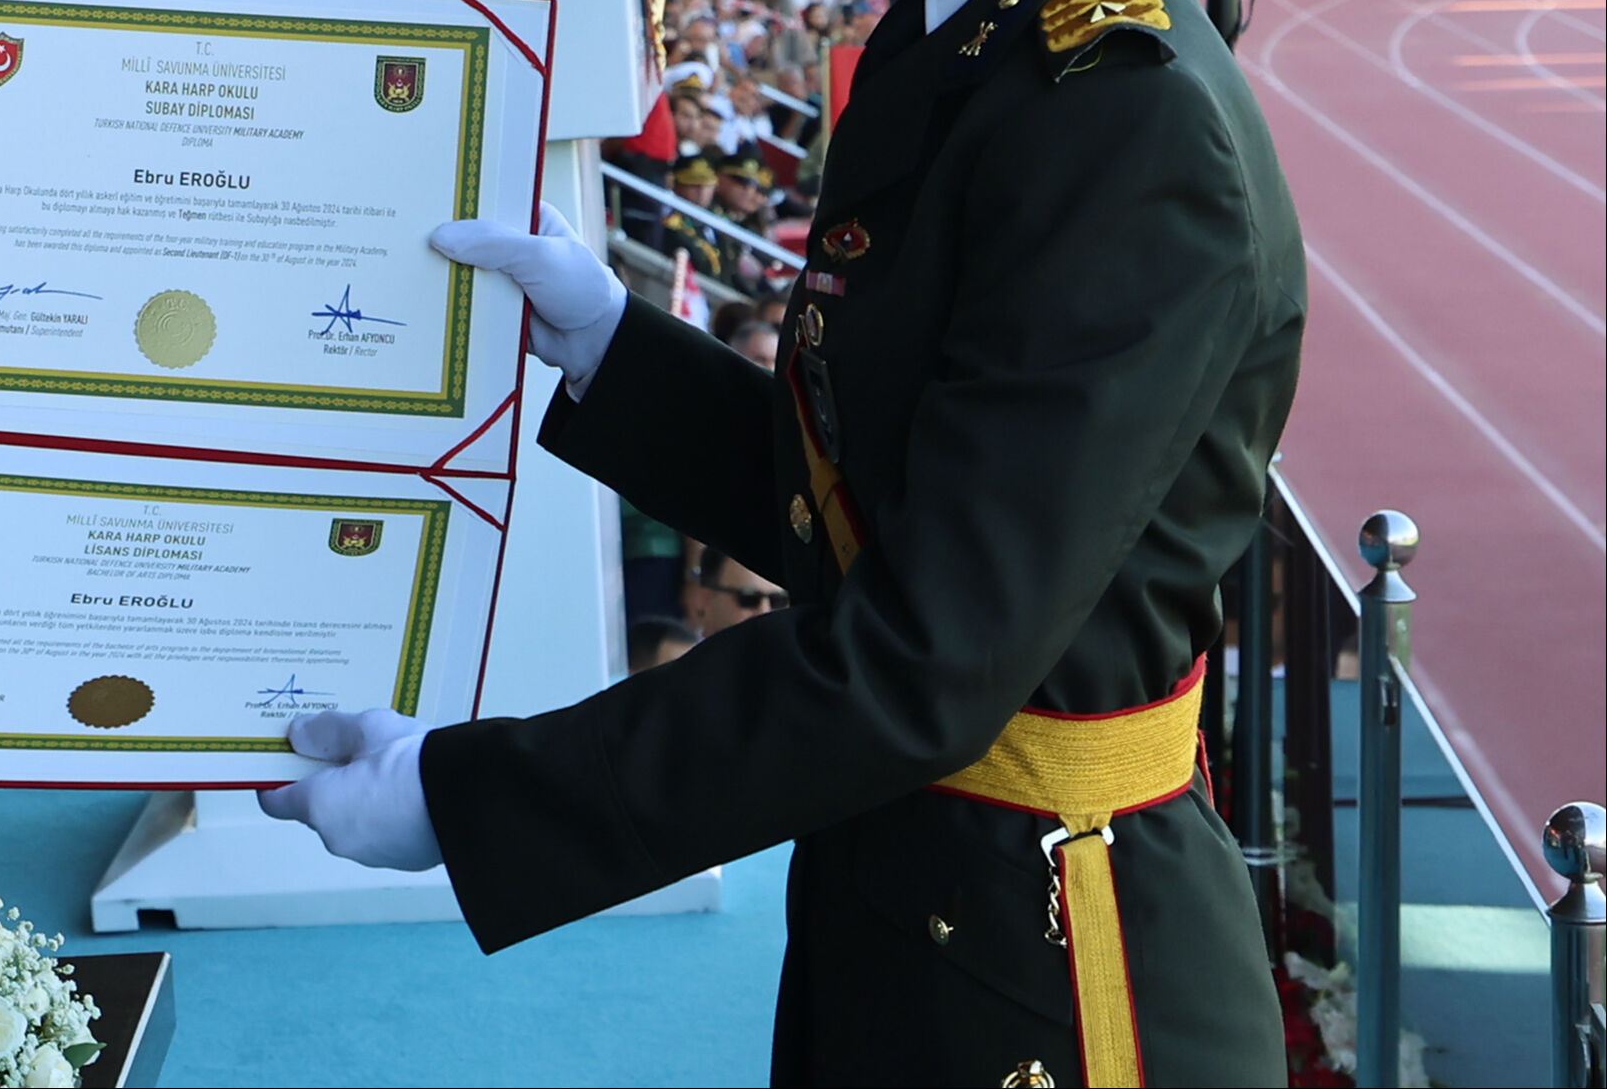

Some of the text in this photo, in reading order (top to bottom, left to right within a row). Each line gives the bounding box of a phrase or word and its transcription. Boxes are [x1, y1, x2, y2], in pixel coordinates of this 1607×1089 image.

[195, 40, 215, 57] T.C.
[156, 60, 210, 76] SAVUNMA
[212, 62, 287, 81] ÜNİVERSİTESİ
[145, 80, 259, 100] KARA HARP OKULU
[145, 100, 255, 120] SUBAY DİPLOMASI
[94, 117, 305, 140] TURKISH NATIONAL DEFENCE UNIVERSITY MILITARY ACADEMY
[181, 136, 214, 148] DIPLOMA
[133, 169, 250, 189] Ebru EROĞLU
[143, 504, 163, 517] T.C.
[99, 516, 154, 530] SAVUNMA
[157, 519, 235, 534] ÜNİVERSİTESİ
[87, 530, 207, 546] KARA HARP OKULU
[83, 543, 203, 561] LİSANS DİPLOMASI
[31, 555, 252, 574] TURKISH NATIONAL DEFENCE UNIVERSITY MILITARY ACADEMY
[85, 568, 192, 581] BACHELOR OF ARTS DIPLOMA
[70, 593, 194, 608] Ebru EROĞLU
